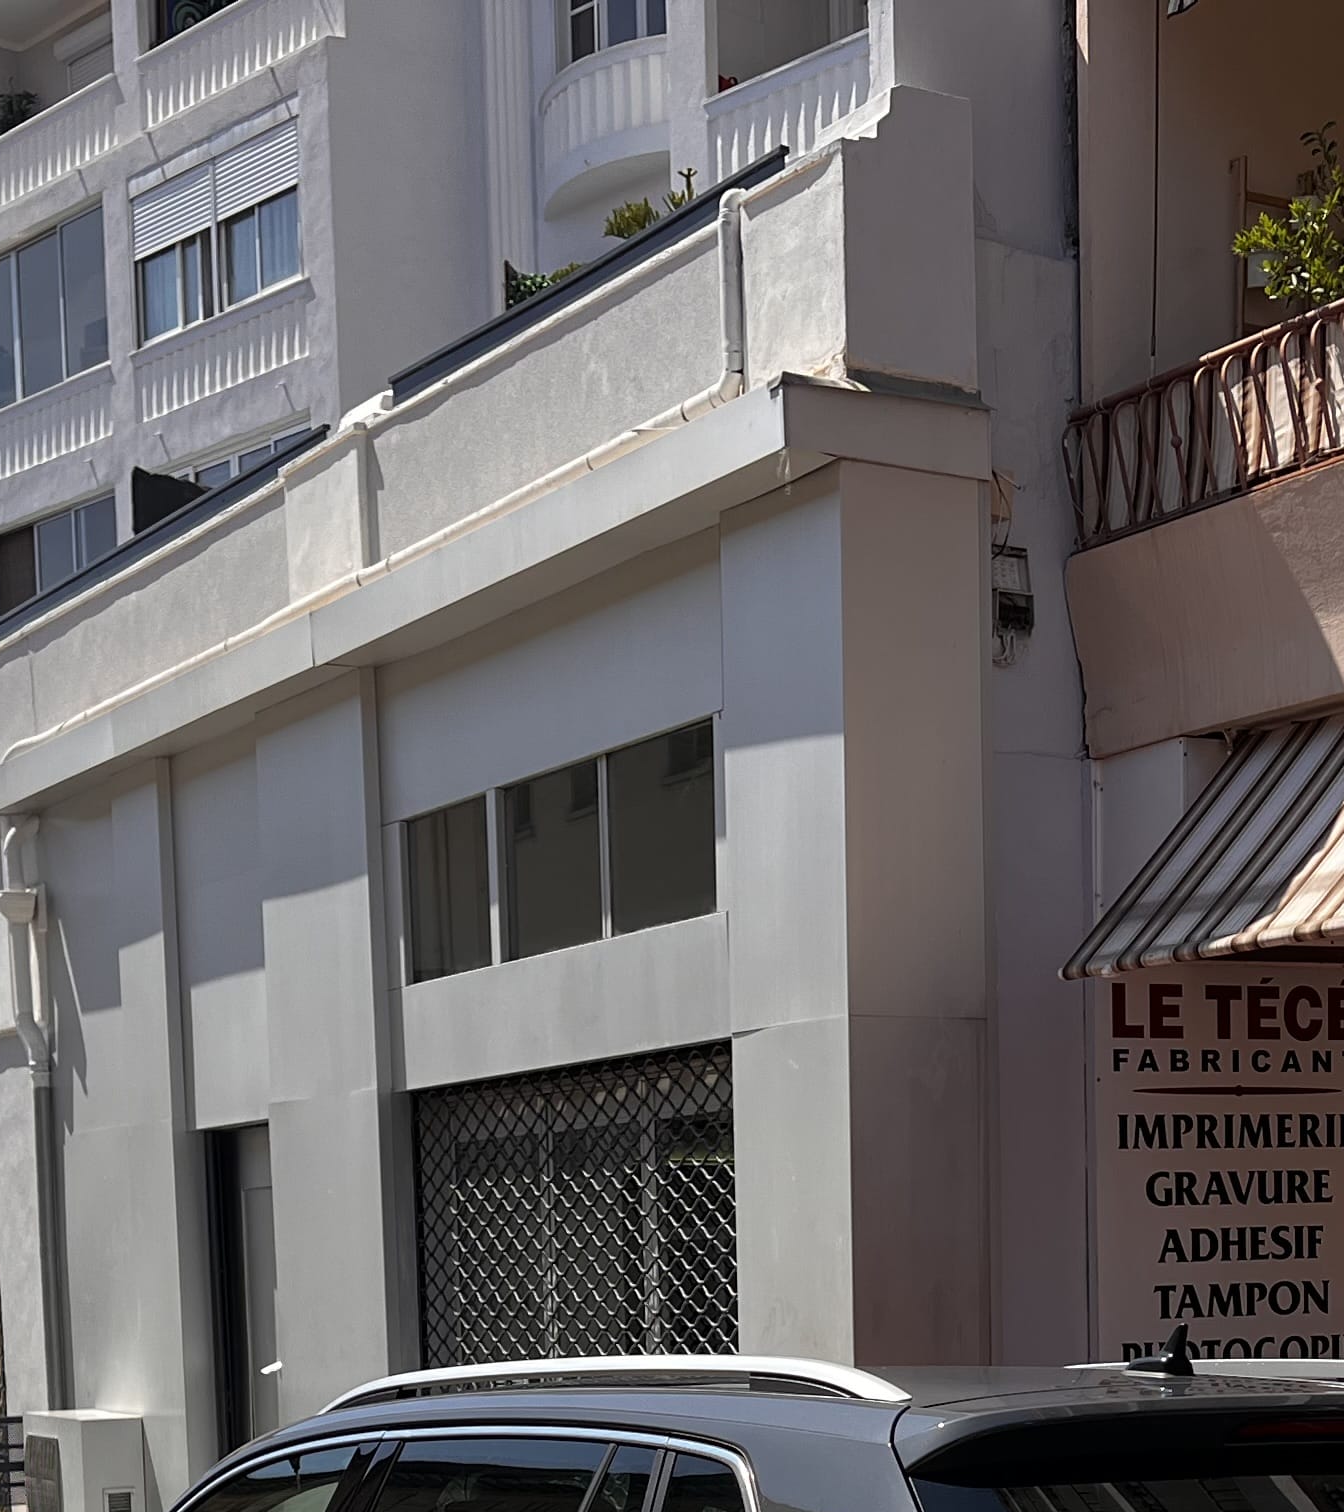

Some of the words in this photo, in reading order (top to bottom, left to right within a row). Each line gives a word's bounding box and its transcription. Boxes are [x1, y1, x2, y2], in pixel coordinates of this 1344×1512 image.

[1111, 983, 1184, 1039] LE
[1145, 1169, 1333, 1207] GRAVURE
[1157, 1225, 1324, 1263] ADHESIF
[1153, 1279, 1330, 1319] TAMPON
